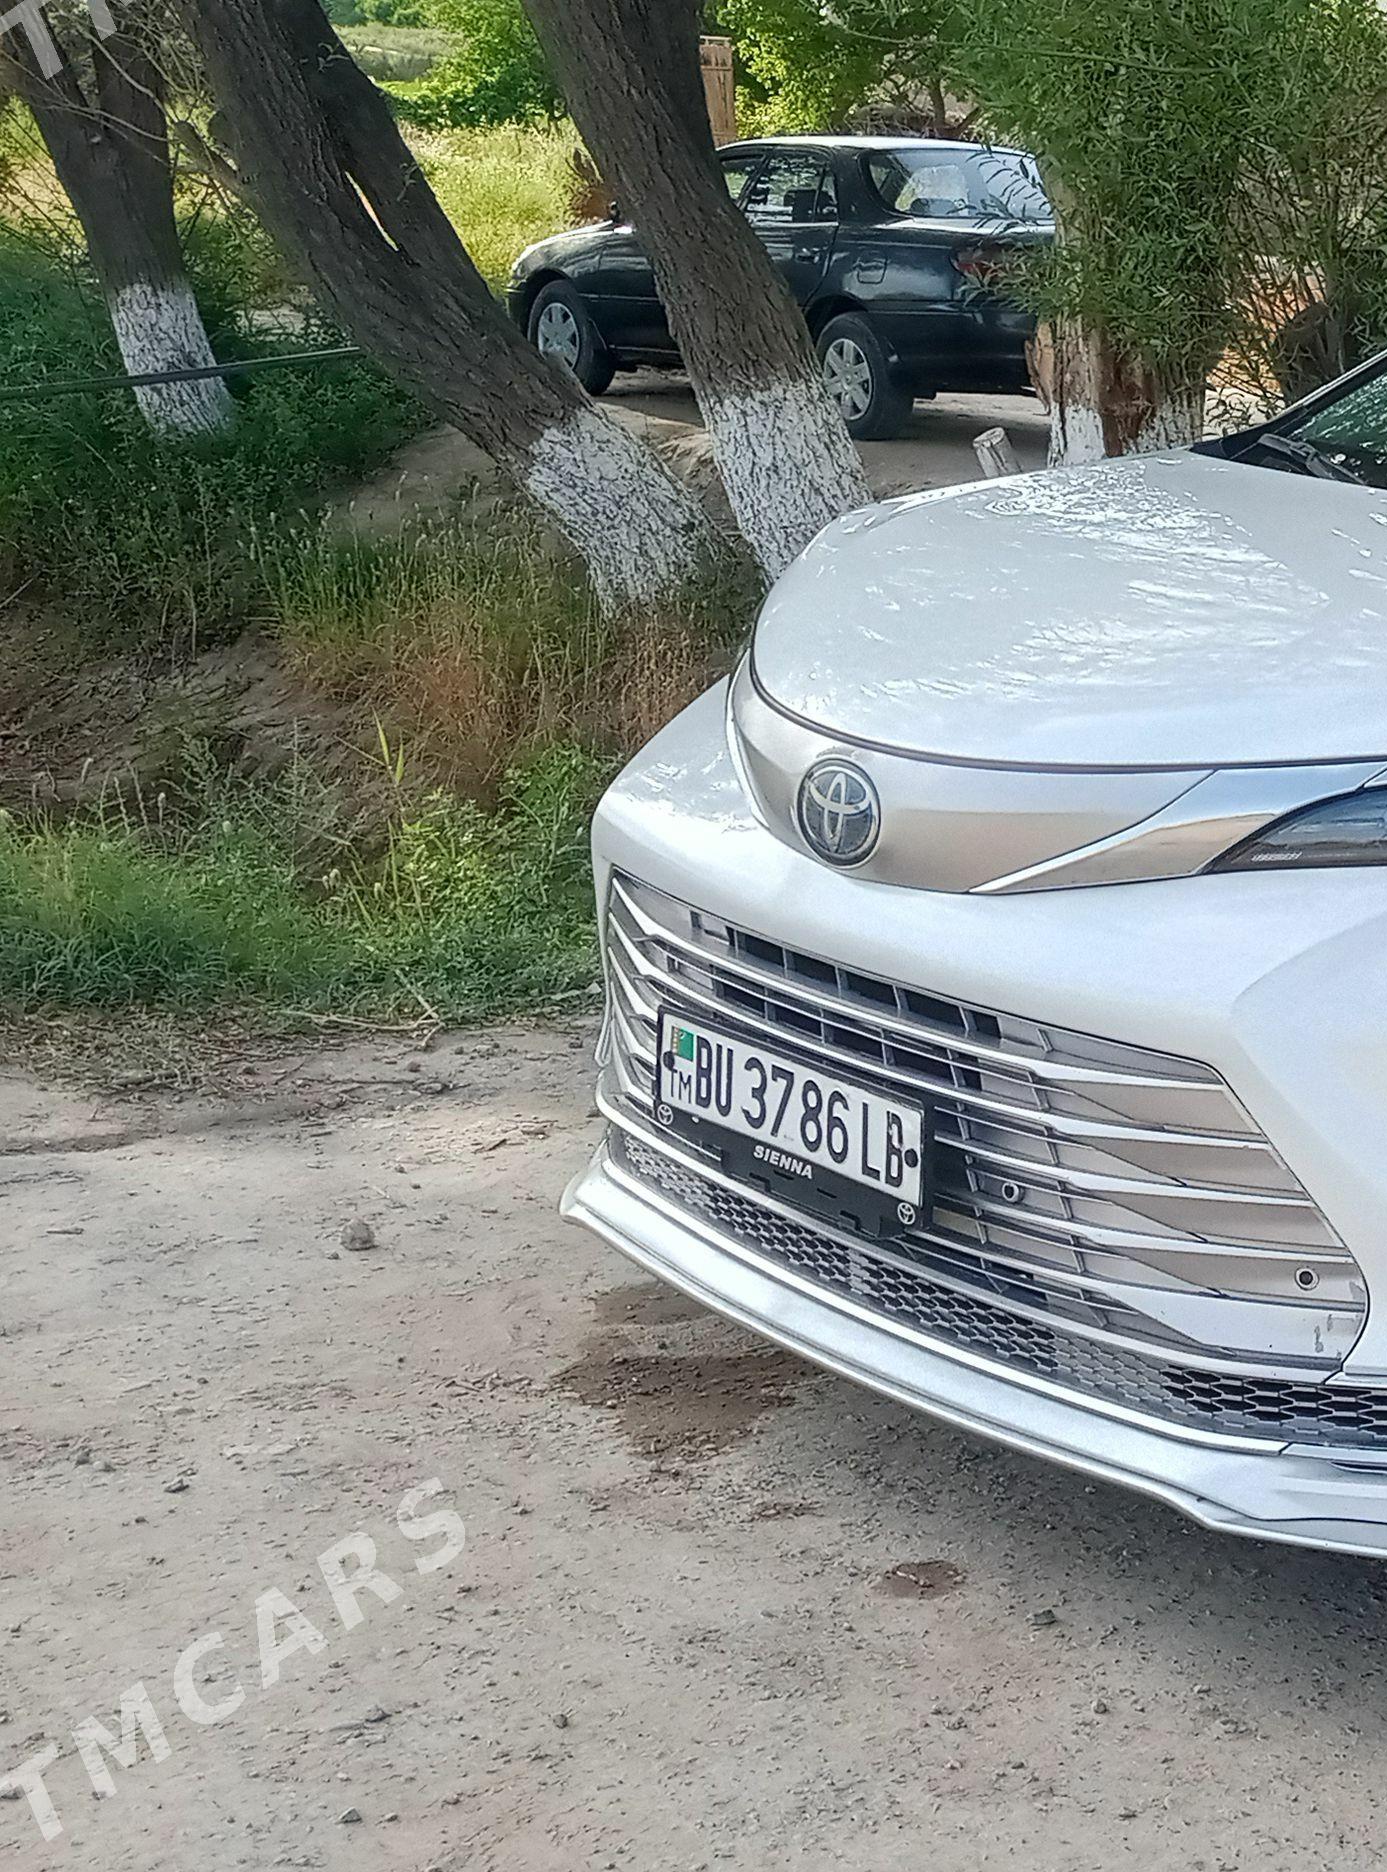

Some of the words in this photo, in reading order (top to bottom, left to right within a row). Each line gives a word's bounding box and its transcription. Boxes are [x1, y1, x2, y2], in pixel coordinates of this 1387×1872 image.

[668, 1068, 693, 1104] TM
[695, 1034, 734, 1117] BU
[741, 1056, 850, 1164] 3786
[861, 1101, 904, 1188] LB
[752, 1144, 814, 1180] SIENNA
